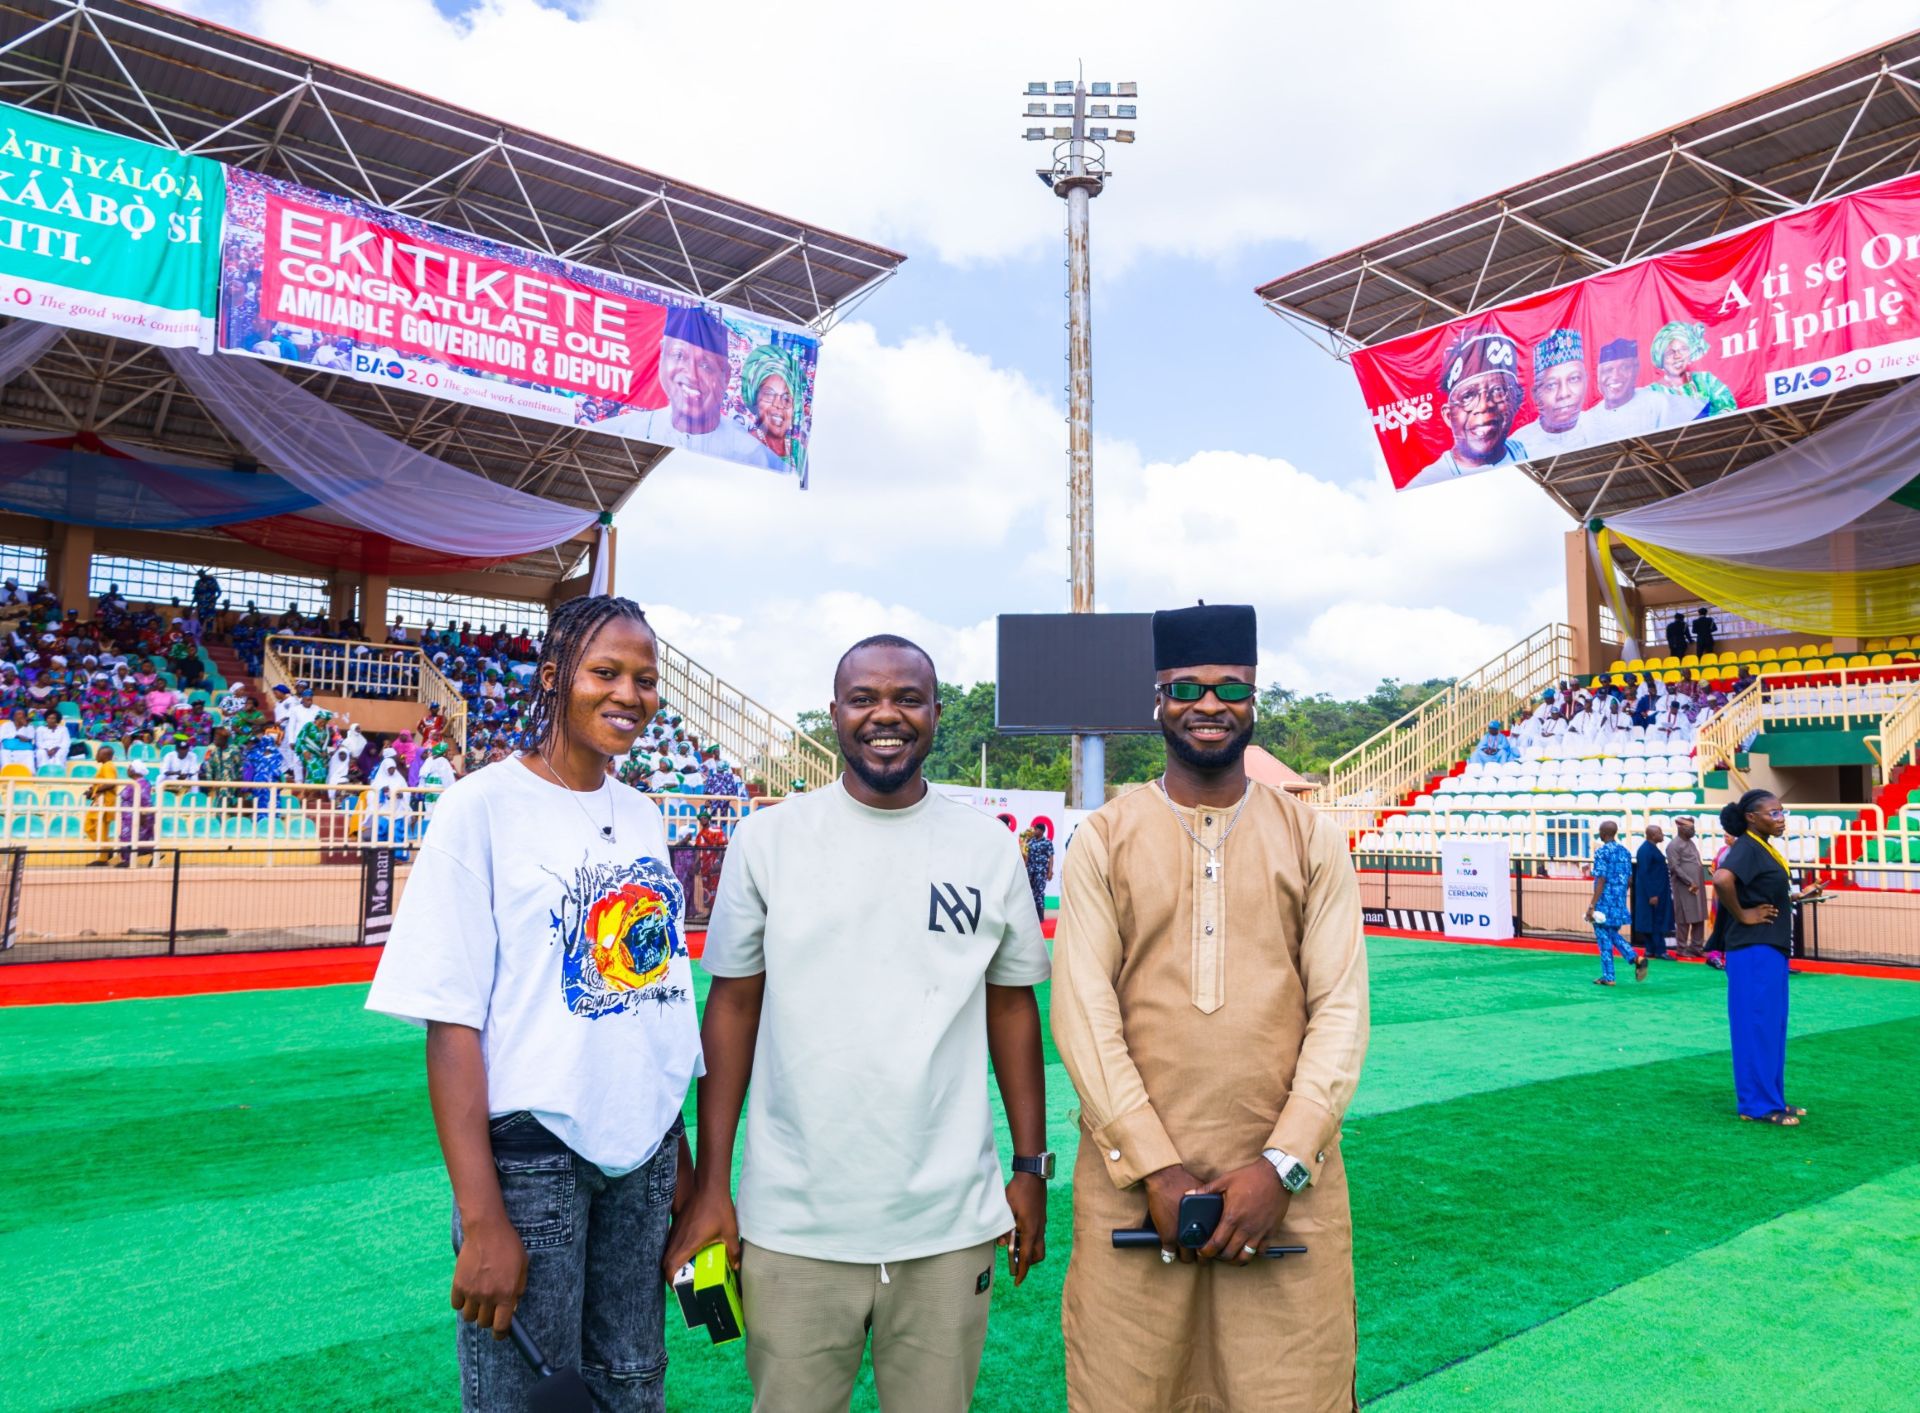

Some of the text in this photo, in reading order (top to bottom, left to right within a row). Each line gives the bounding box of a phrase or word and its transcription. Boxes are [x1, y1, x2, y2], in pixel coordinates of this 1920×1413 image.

[0, 215, 92, 266] ITI.
[280, 208, 628, 341] EKITIKETE
[1718, 279, 1752, 314] A
[1762, 263, 1792, 300] ti
[1804, 256, 1847, 289] se
[39, 293, 66, 310] The
[69, 304, 107, 319] good
[111, 310, 147, 328] work
[278, 257, 632, 366] CONGRATULATE OUR
[278, 284, 634, 395] AMIABLE GOVERNOR & DEPUTY
[407, 369, 438, 388] 2.0
[442, 377, 461, 391] The
[463, 386, 488, 398] good
[491, 392, 515, 404] work
[1834, 358, 1872, 382] 2.0
[1879, 356, 1902, 369] The
[1386, 392, 1433, 412] RENEWED
[1368, 402, 1433, 444] Hope
[1448, 889, 1488, 898] CEREMONY
[1449, 913, 1491, 927] VIP D
